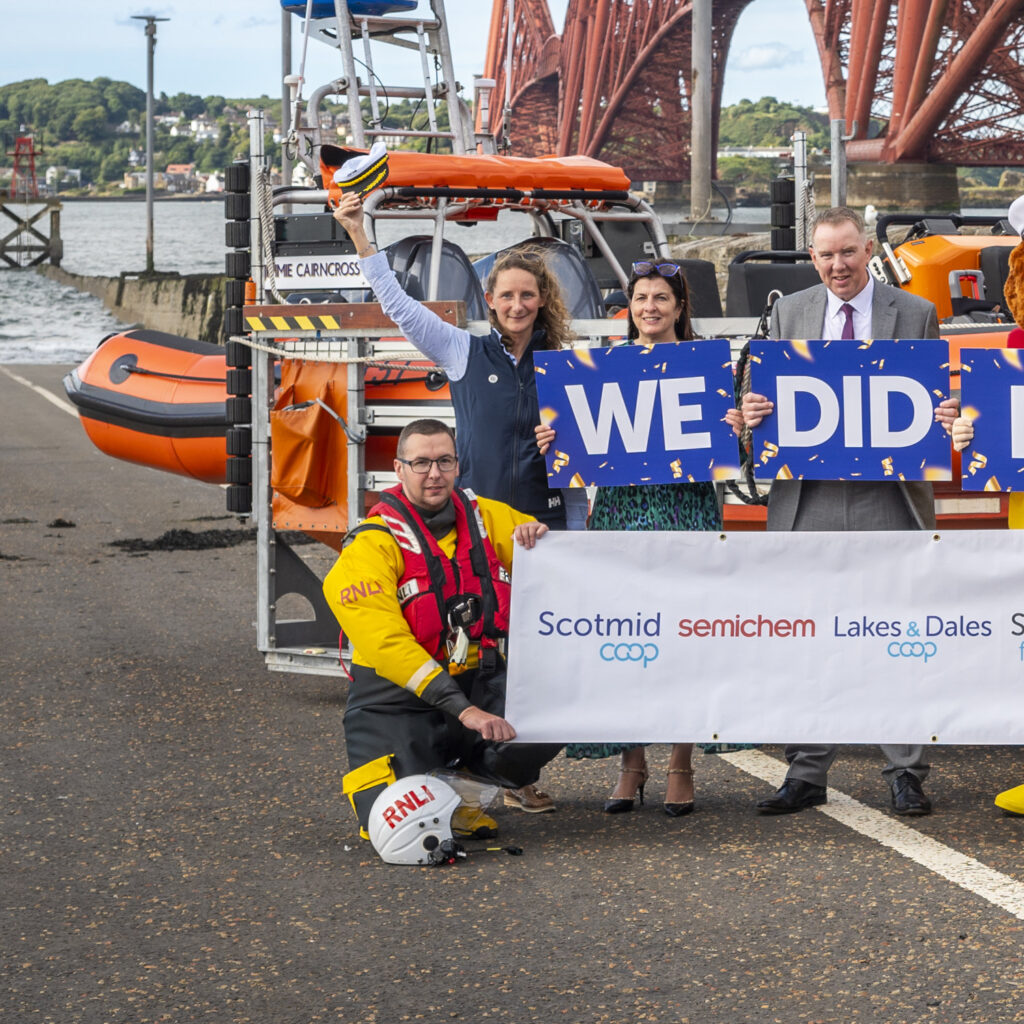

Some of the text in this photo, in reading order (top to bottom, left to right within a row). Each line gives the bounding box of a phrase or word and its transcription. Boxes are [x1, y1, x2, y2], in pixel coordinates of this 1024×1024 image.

[296, 262, 360, 277] CAIRNCROSS
[564, 376, 711, 455] WE
[776, 375, 933, 448] DID
[340, 580, 384, 607] RNLI
[397, 583, 412, 600] NLI
[538, 611, 660, 637] Scotmid
[678, 614, 816, 638] semichem
[834, 615, 992, 637] Lakes & Dales
[600, 642, 659, 668] coop
[887, 641, 937, 663] coop
[382, 785, 435, 829] RNLI
